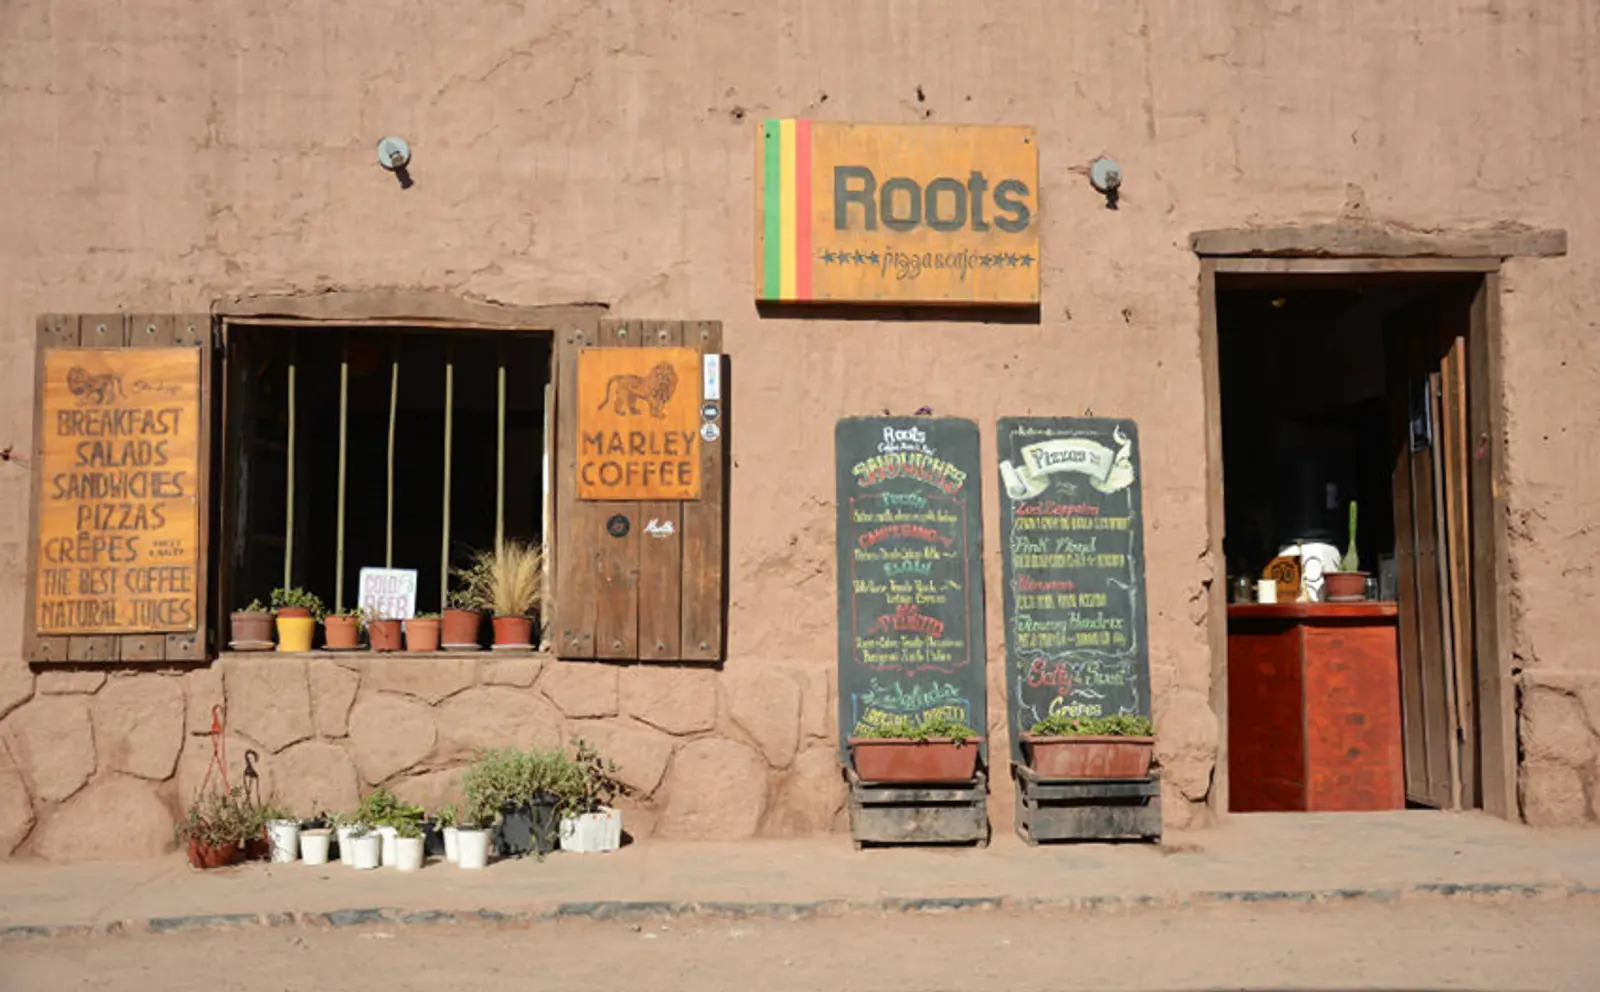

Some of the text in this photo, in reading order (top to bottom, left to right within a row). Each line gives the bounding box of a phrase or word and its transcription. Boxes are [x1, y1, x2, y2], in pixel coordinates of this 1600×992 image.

[833, 165, 1031, 233] Roots
[56, 408, 184, 437] BREAKFAST
[882, 426, 926, 443] Roots
[75, 439, 168, 468] SALADS
[582, 430, 696, 456] MARLEY
[52, 470, 187, 500] SANDWICHES
[581, 460, 693, 488] COFFEE
[852, 451, 968, 494] SANDWICHES
[76, 502, 166, 531] PIZZAS
[43, 531, 141, 564] CRÊPES
[42, 565, 192, 596] THE BEST COFFEE
[41, 597, 192, 629] NATURAL JUICES
